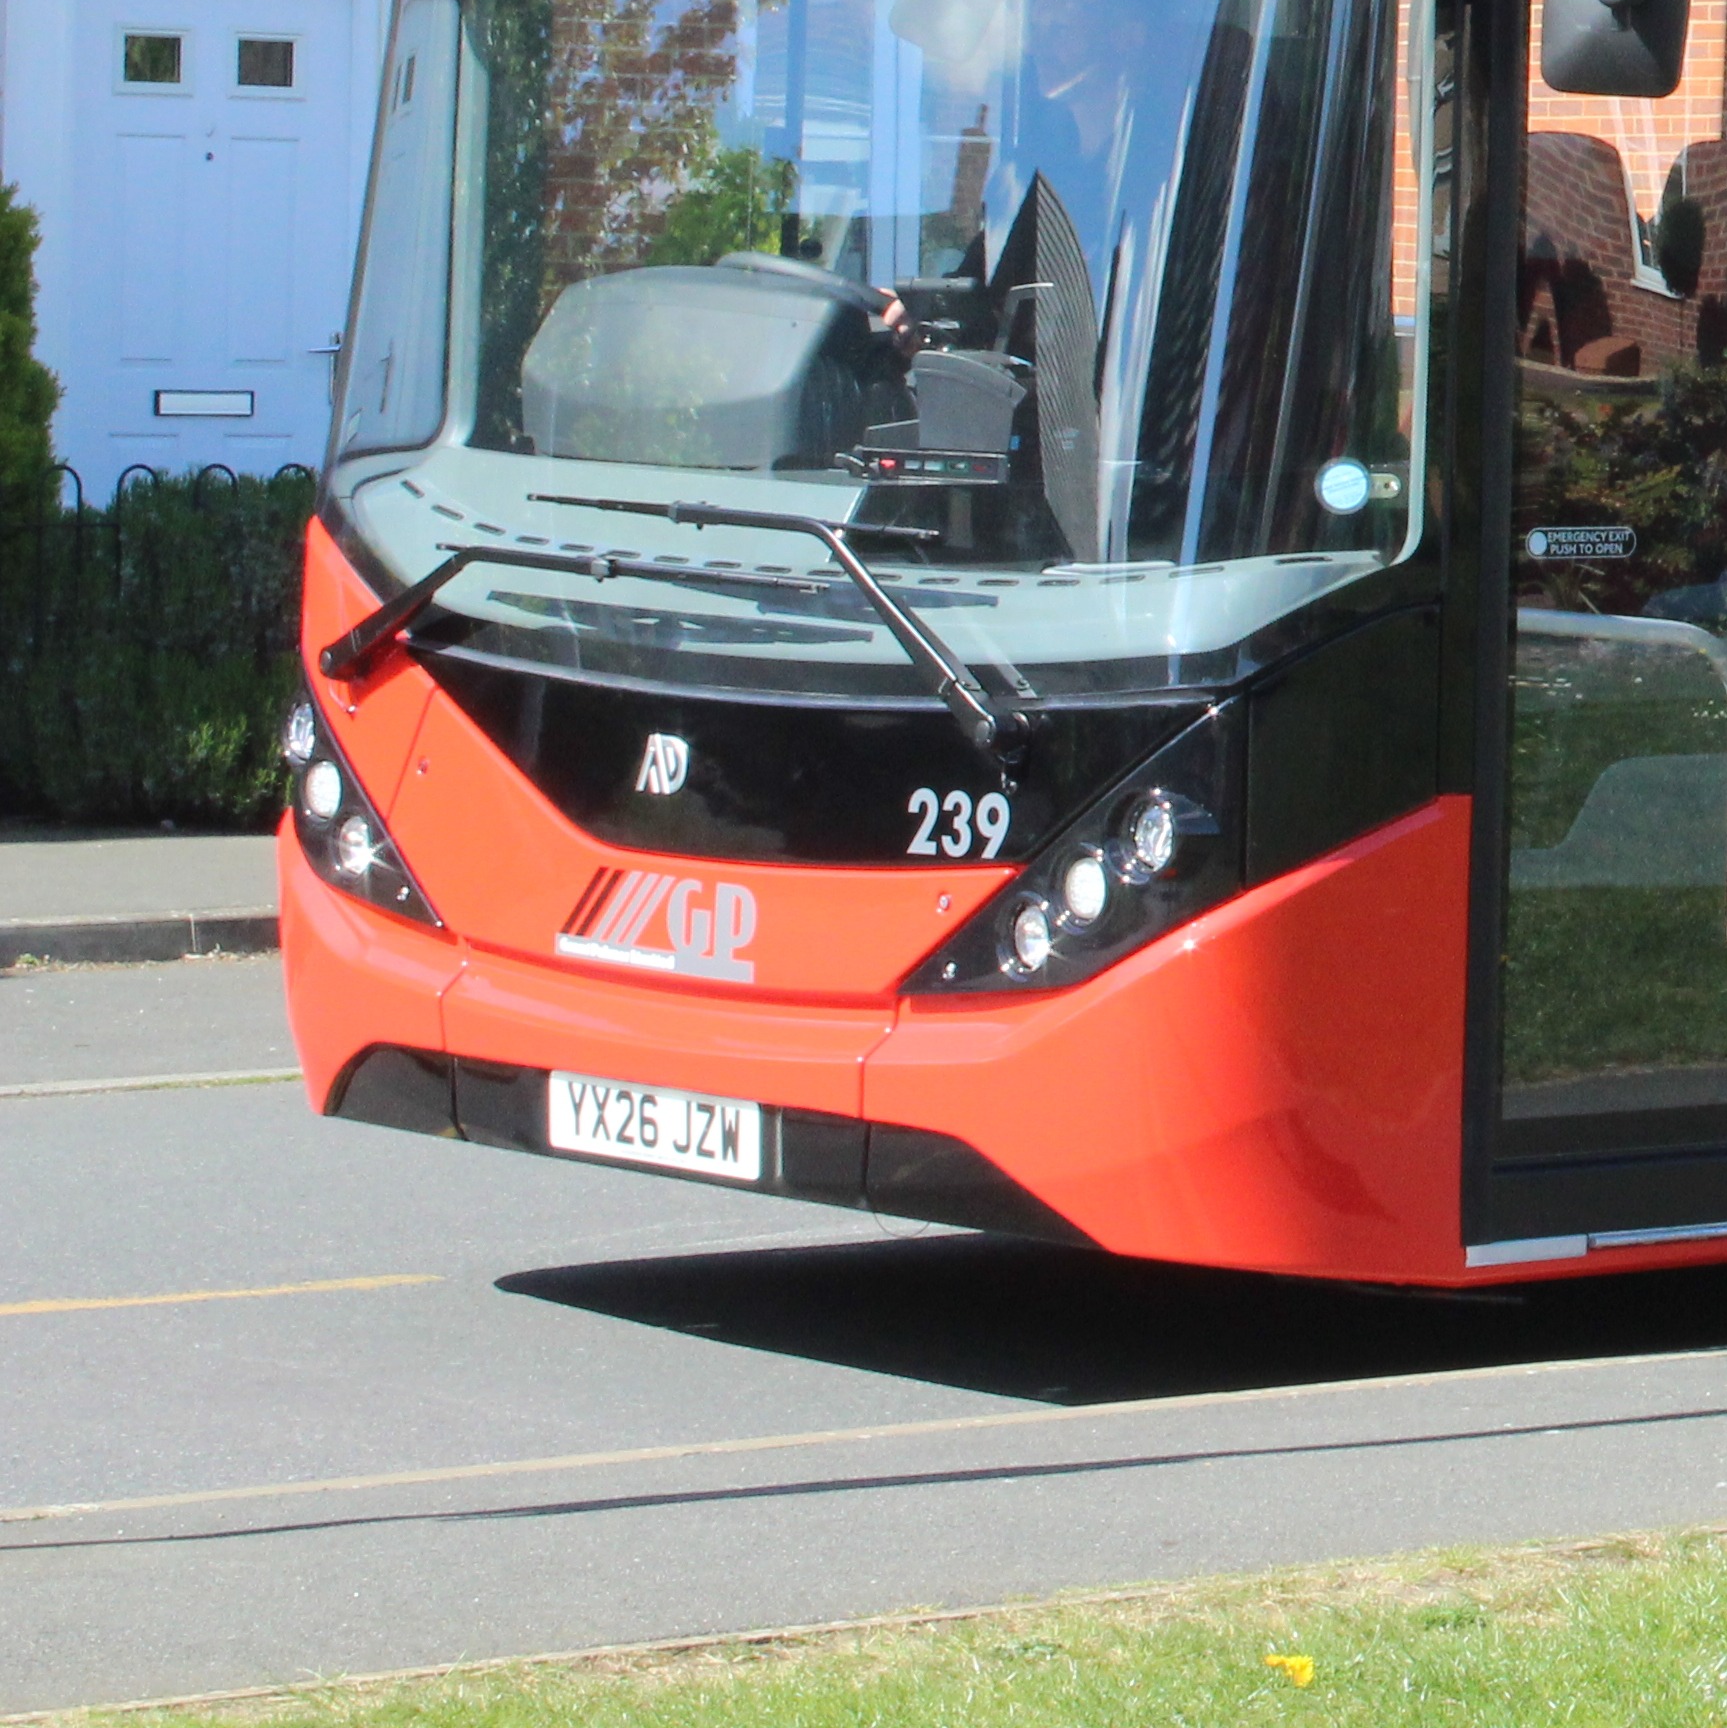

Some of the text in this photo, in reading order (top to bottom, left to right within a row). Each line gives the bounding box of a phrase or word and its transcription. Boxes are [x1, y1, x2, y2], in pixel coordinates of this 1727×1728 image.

[1547, 530, 1631, 543] EMERGENCY EXIT
[1549, 543, 1623, 555] PUSH TO OPEN
[905, 787, 1011, 860] 239
[666, 878, 758, 962] GP
[567, 1080, 741, 1163] YX26 JZW
